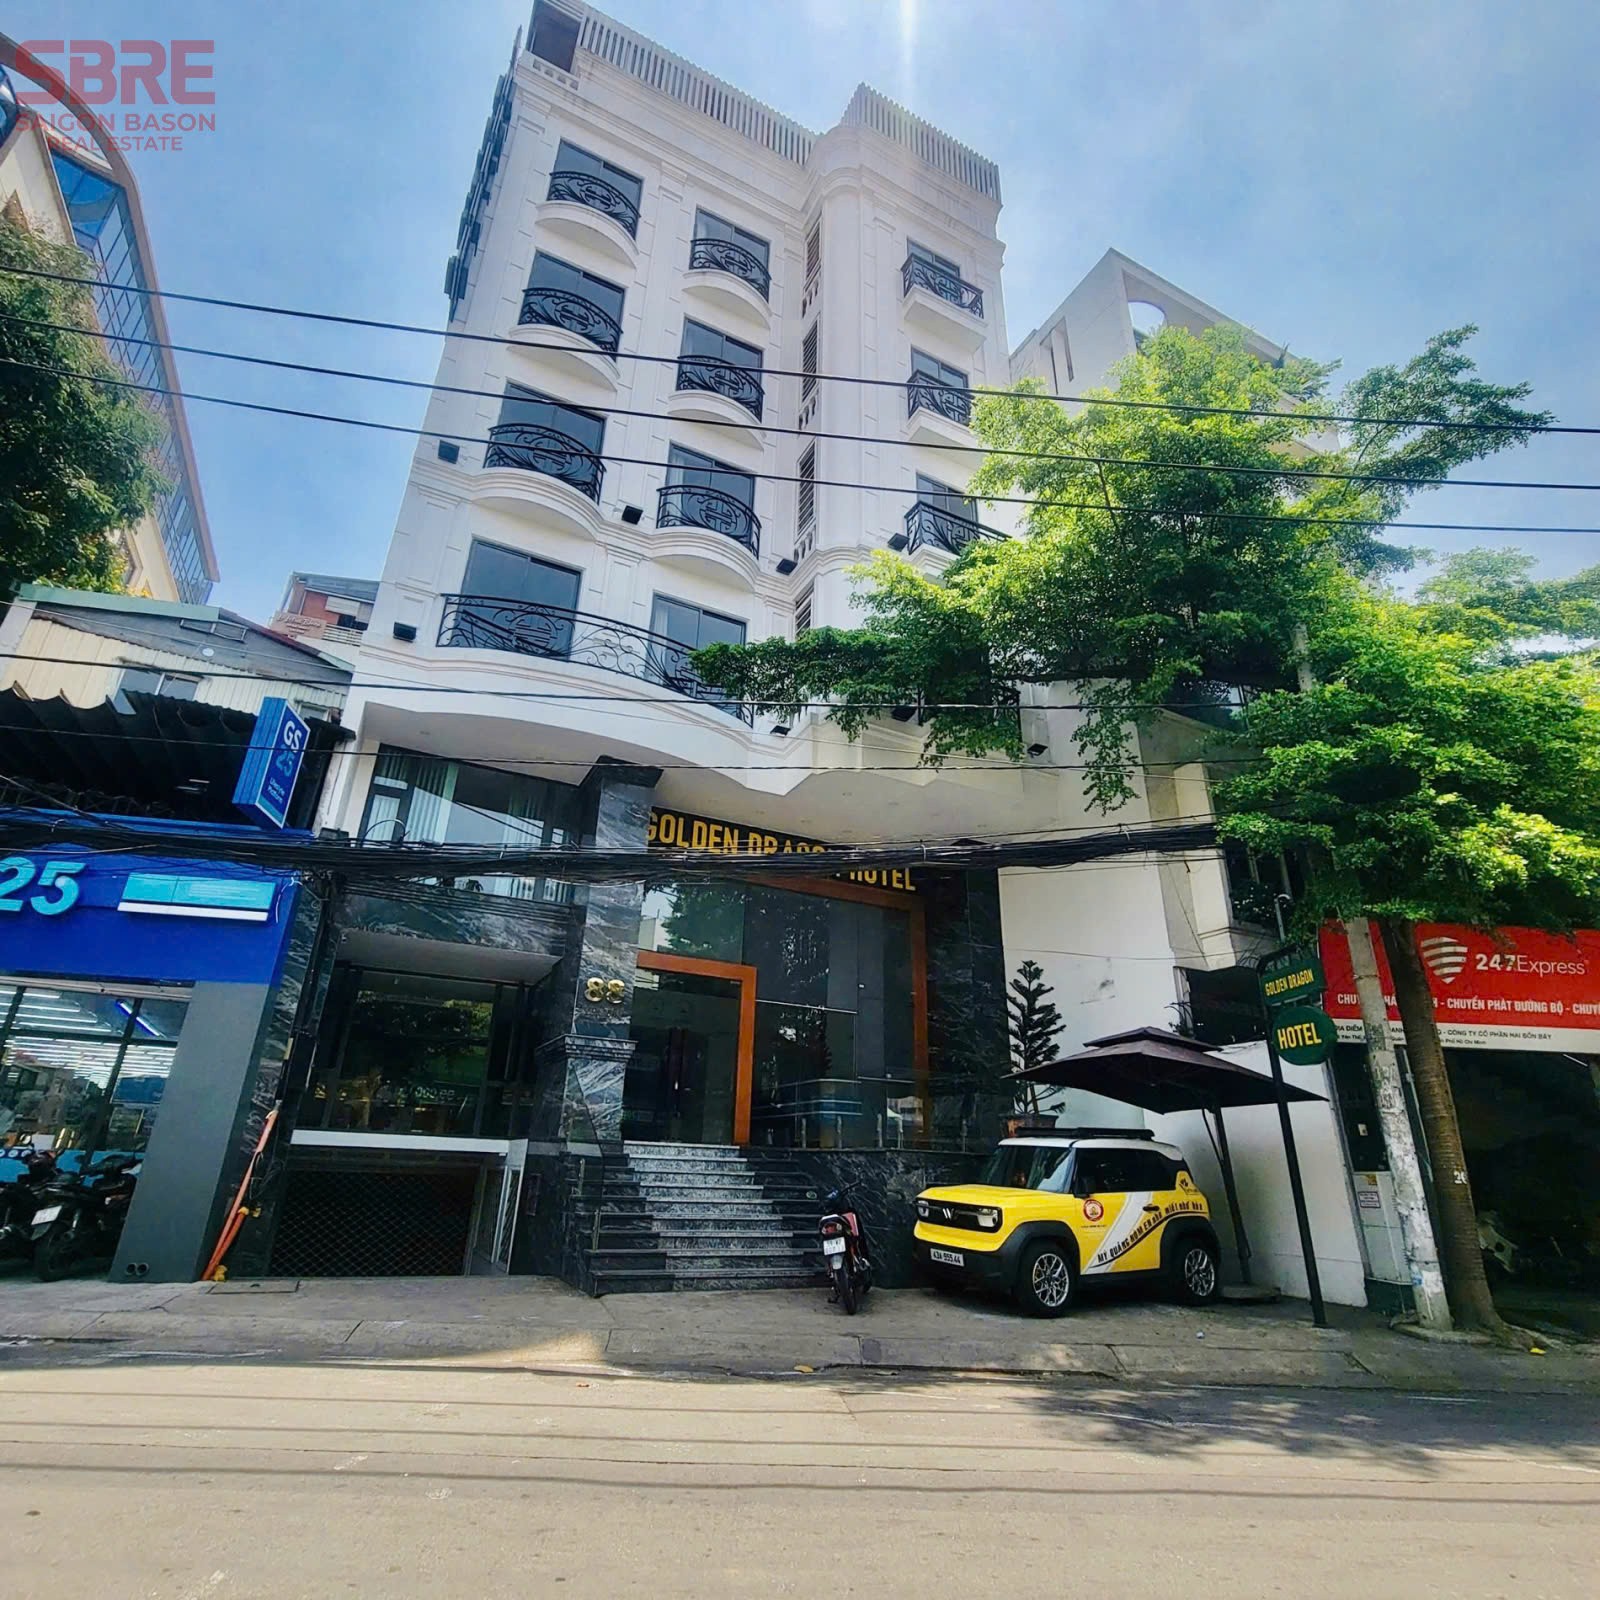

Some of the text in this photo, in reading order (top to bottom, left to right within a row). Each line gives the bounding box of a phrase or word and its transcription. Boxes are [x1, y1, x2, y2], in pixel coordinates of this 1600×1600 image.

[283, 720, 302, 752] GS
[1265, 968, 1315, 996] GOLDEN DRAGON
[1277, 1022, 1322, 1050] HOTEL
